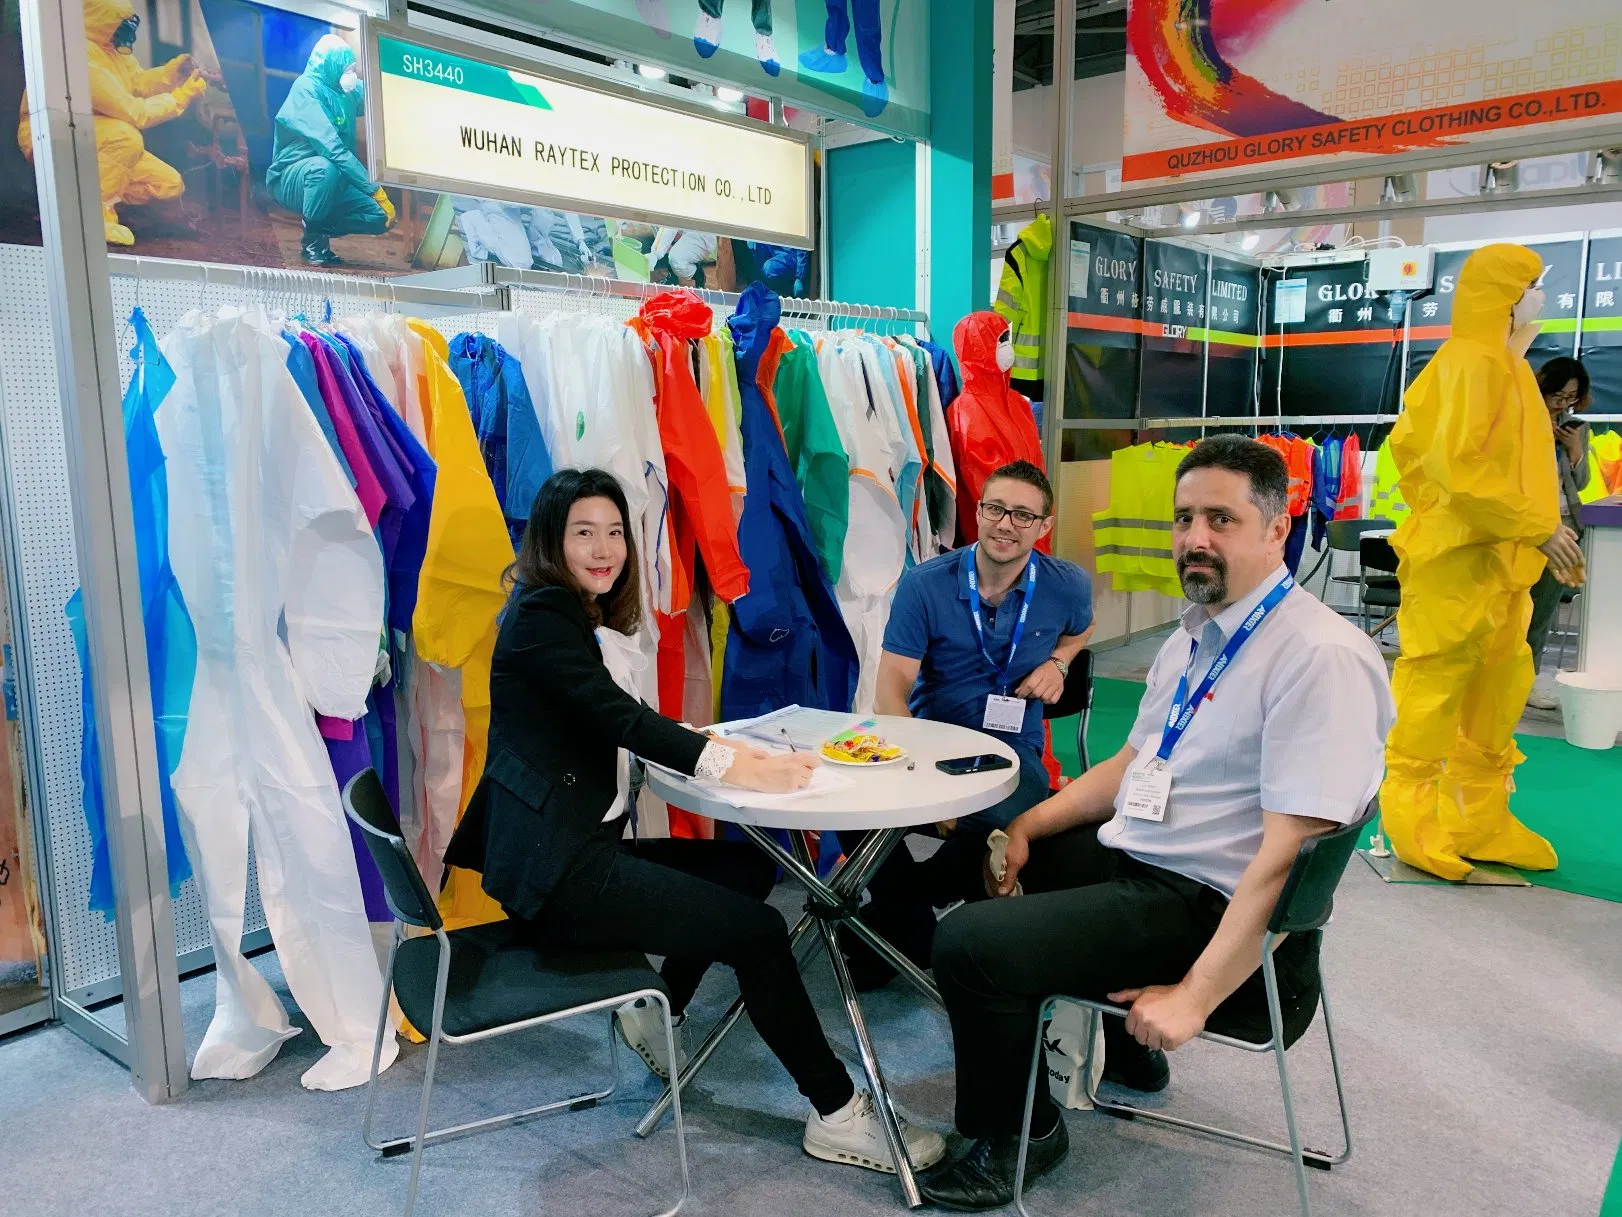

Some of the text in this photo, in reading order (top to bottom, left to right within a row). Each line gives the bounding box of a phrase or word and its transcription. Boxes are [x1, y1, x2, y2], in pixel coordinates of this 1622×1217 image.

[402, 54, 464, 85] SH3440
[460, 125, 522, 158] WUHAN
[535, 140, 600, 173] RAYTEX
[611, 156, 706, 193] PROTECTION
[1167, 147, 1238, 170] QUZHOU
[1243, 134, 1308, 157] GLORY
[1311, 121, 1386, 149] SAFETY
[1391, 105, 1502, 137] CLOTHING
[1095, 256, 1137, 281] GLORY
[1153, 269, 1198, 294] SAFETY
[1211, 280, 1248, 302] LIMITED
[1162, 323, 1187, 338] GLORY
